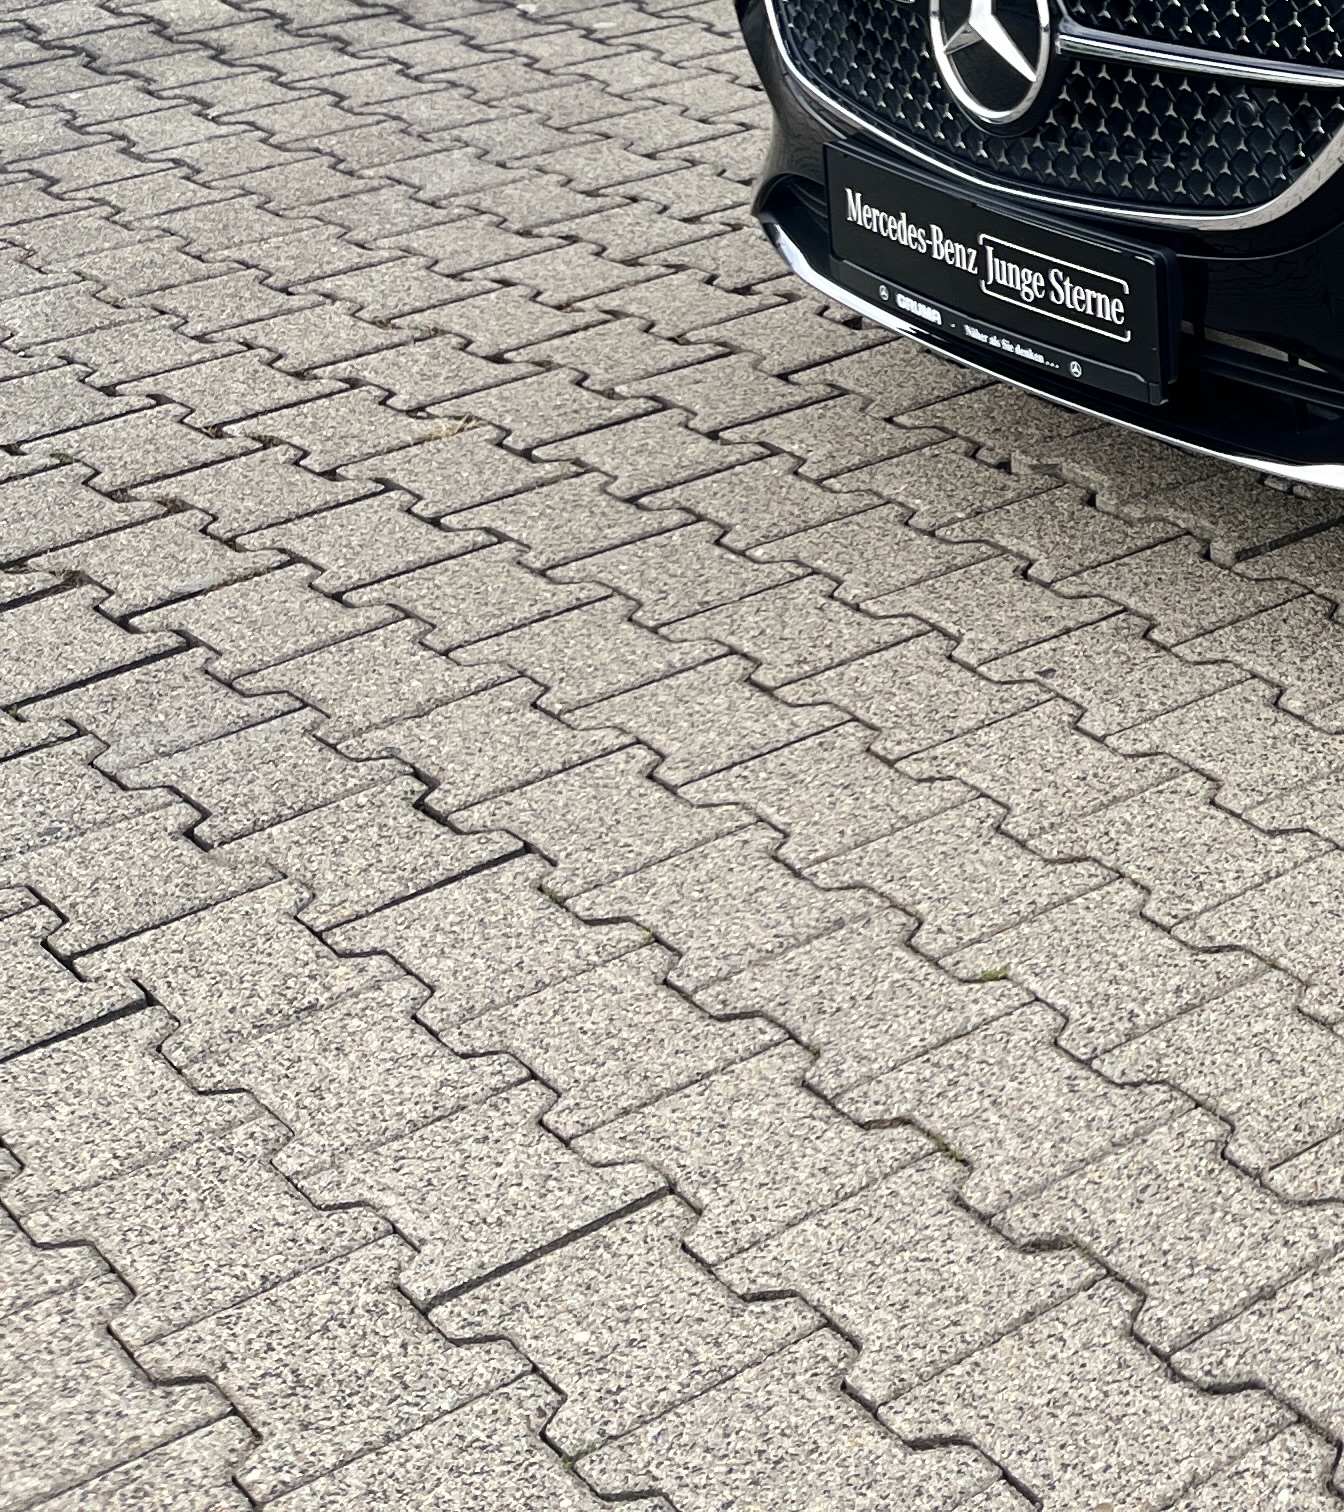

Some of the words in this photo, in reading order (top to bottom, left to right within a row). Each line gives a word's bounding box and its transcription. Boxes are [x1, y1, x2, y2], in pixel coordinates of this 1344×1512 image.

[844, 188, 978, 275] Mercedes-Benz
[985, 245, 1045, 303] Junge
[1050, 268, 1125, 325] Sterne
